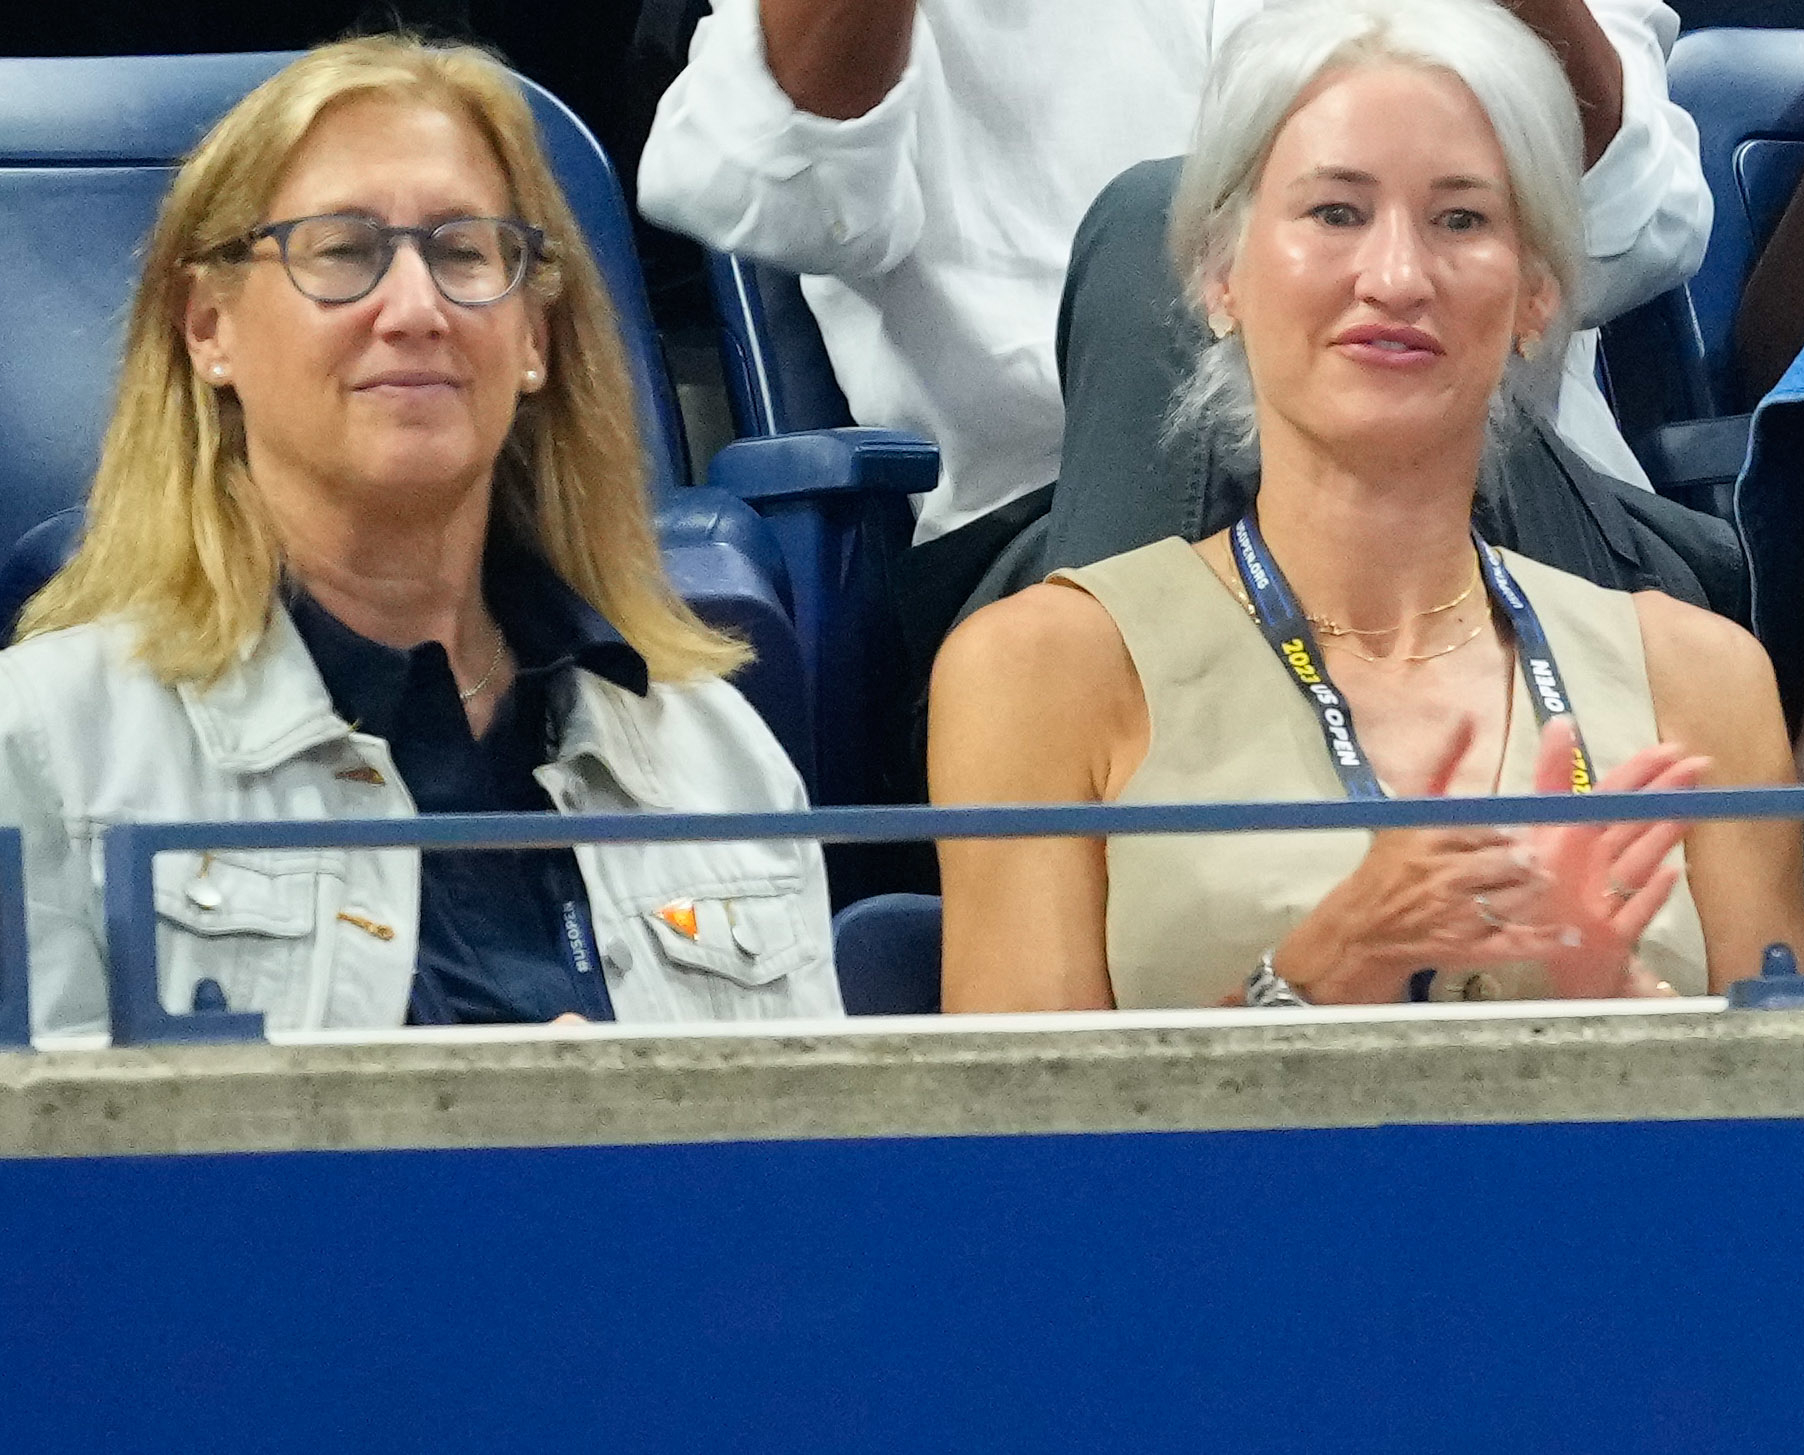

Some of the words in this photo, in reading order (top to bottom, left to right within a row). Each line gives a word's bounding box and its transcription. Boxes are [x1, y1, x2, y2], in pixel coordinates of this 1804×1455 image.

[1310, 684, 1339, 705] US
[1530, 658, 1565, 713] OPEN
[1324, 707, 1360, 766] OPEN
